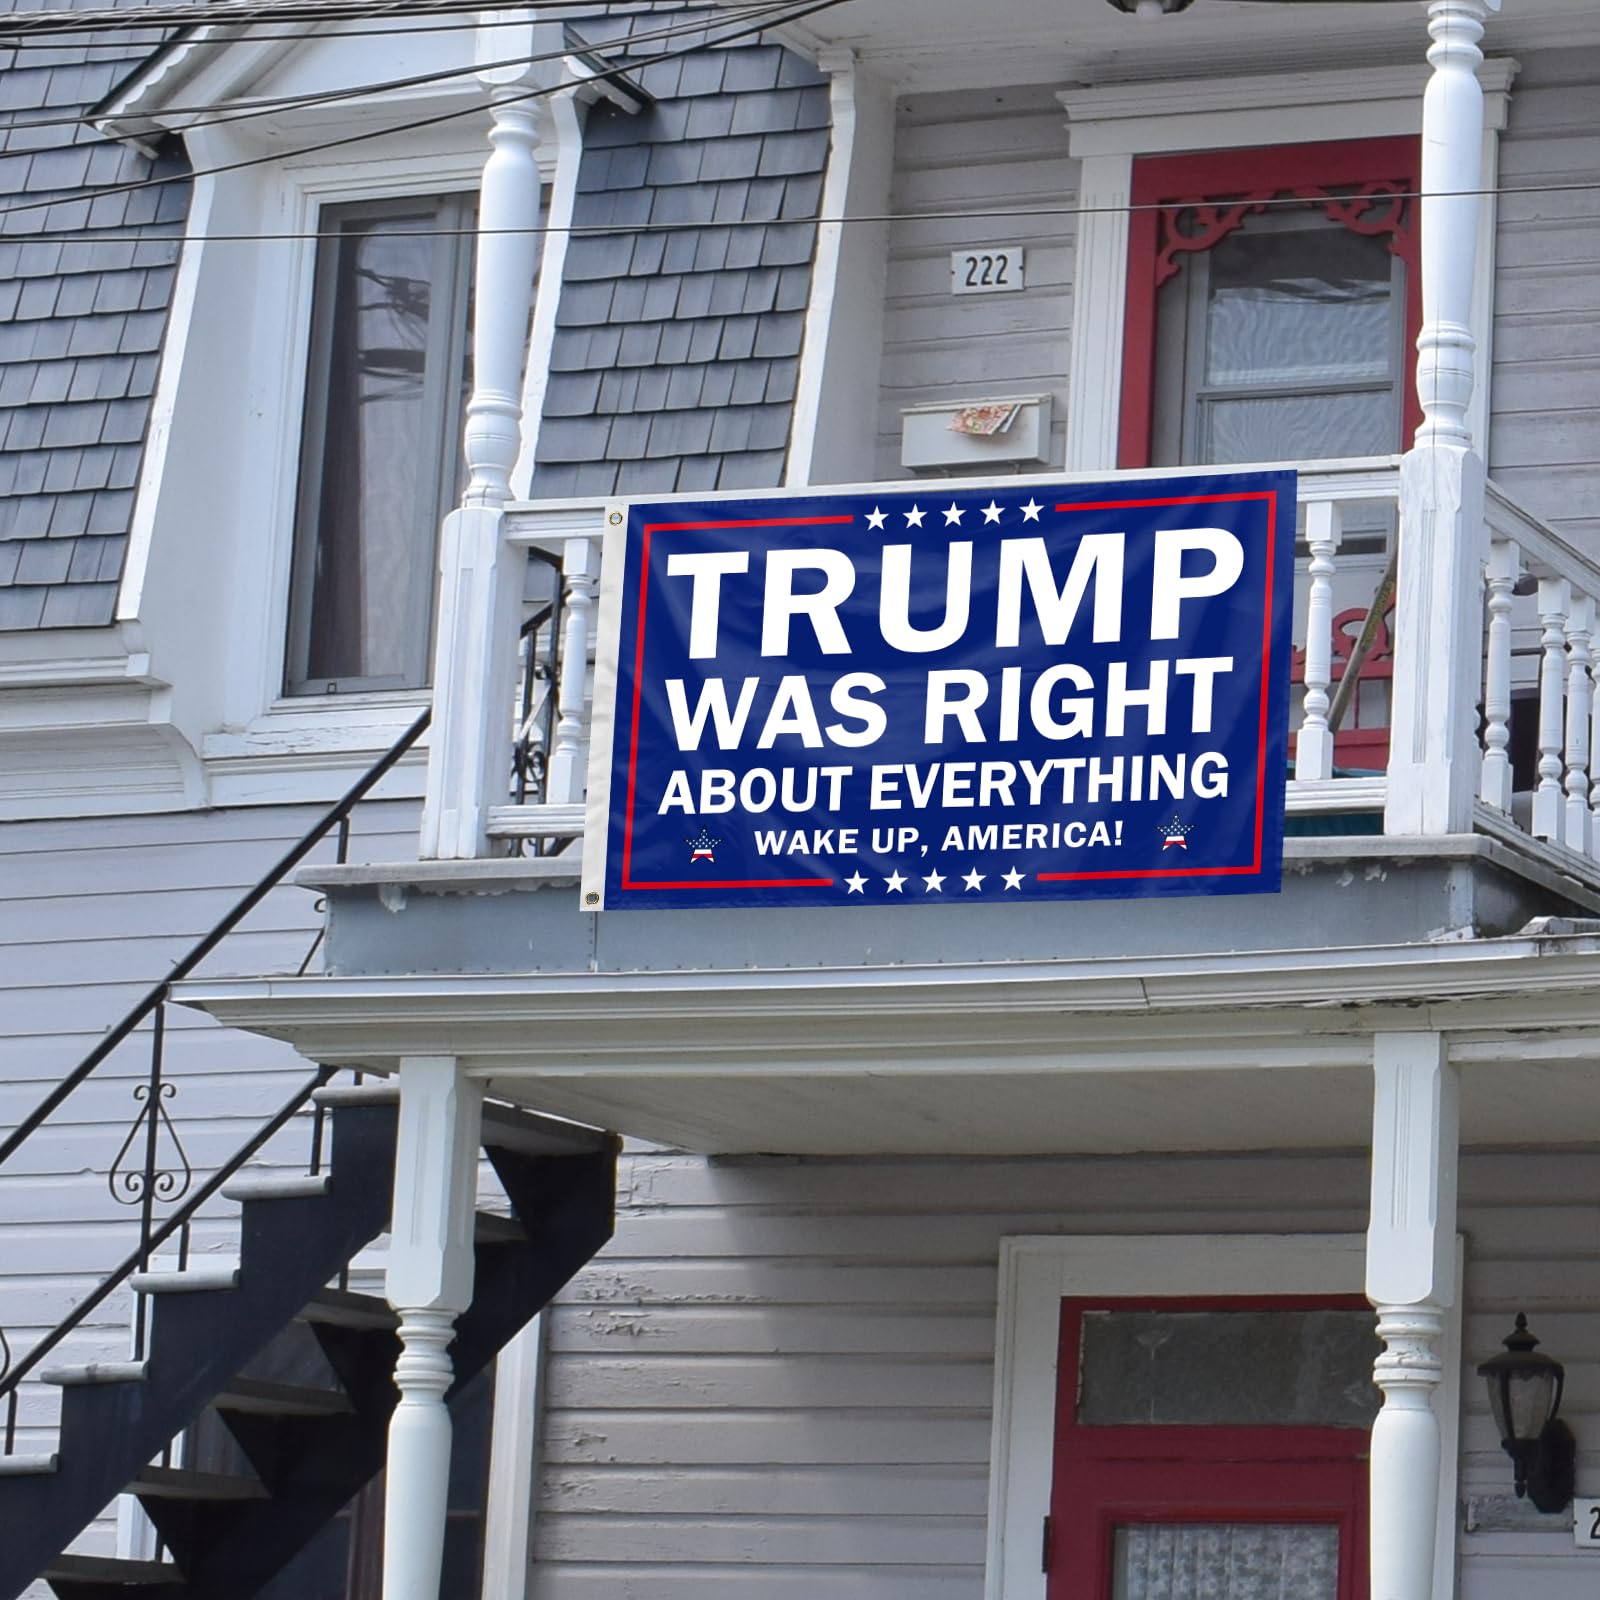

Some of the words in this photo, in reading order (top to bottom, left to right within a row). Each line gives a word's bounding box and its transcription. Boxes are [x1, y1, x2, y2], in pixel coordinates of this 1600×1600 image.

[966, 254, 1008, 286] 222
[667, 528, 1243, 659] TRUMP
[665, 672, 887, 750] WAS
[925, 657, 1233, 743] RIGHT
[658, 766, 852, 814] ABOUT
[870, 752, 1228, 810] EVERYTHING
[754, 828, 858, 856] WAKE
[871, 826, 928, 858] UP,
[941, 821, 1123, 851] AMERICA!
